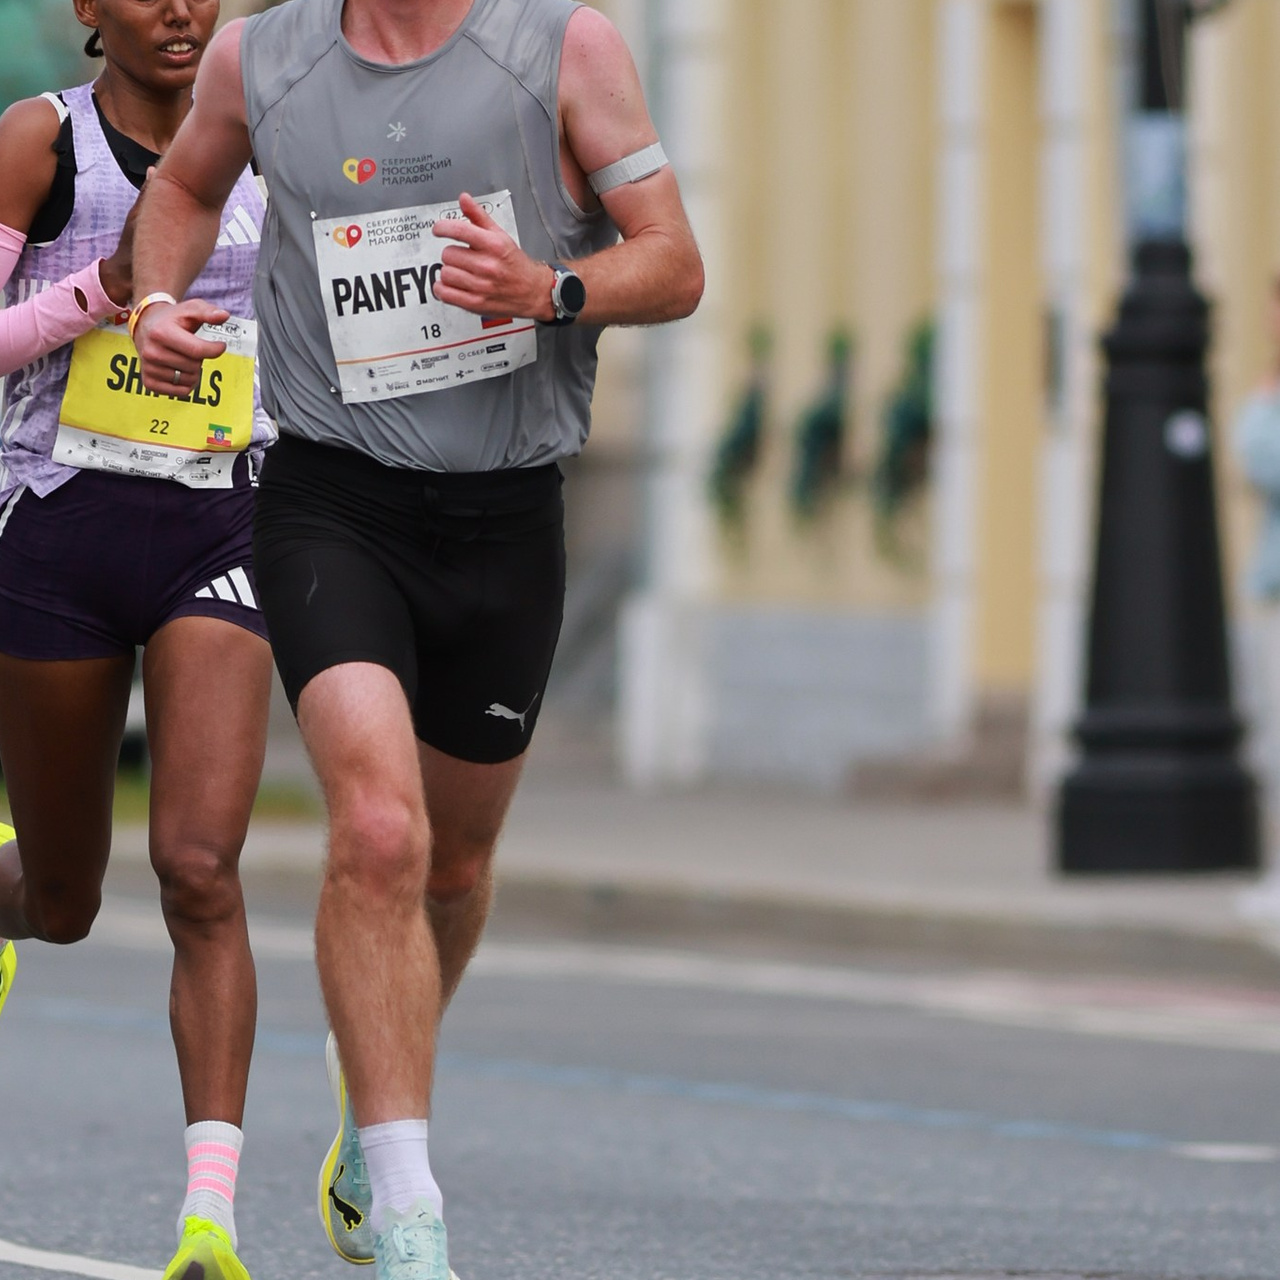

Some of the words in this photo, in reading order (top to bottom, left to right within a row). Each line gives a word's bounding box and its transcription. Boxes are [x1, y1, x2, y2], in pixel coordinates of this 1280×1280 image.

[382, 154, 433, 166] СБЕРПРАЙМ
[382, 157, 452, 175] МОСКОВСКИЙ
[382, 173, 433, 186] МАРАФОН
[366, 215, 417, 228] СБЕРПРАЙМ
[367, 219, 435, 237] МОСКОВСКИЙ
[369, 232, 420, 246] МАРАФОН
[332, 263, 443, 317] PANFYO
[421, 323, 441, 340] 18
[107, 353, 222, 407] SHLS
[149, 419, 170, 435] 22
